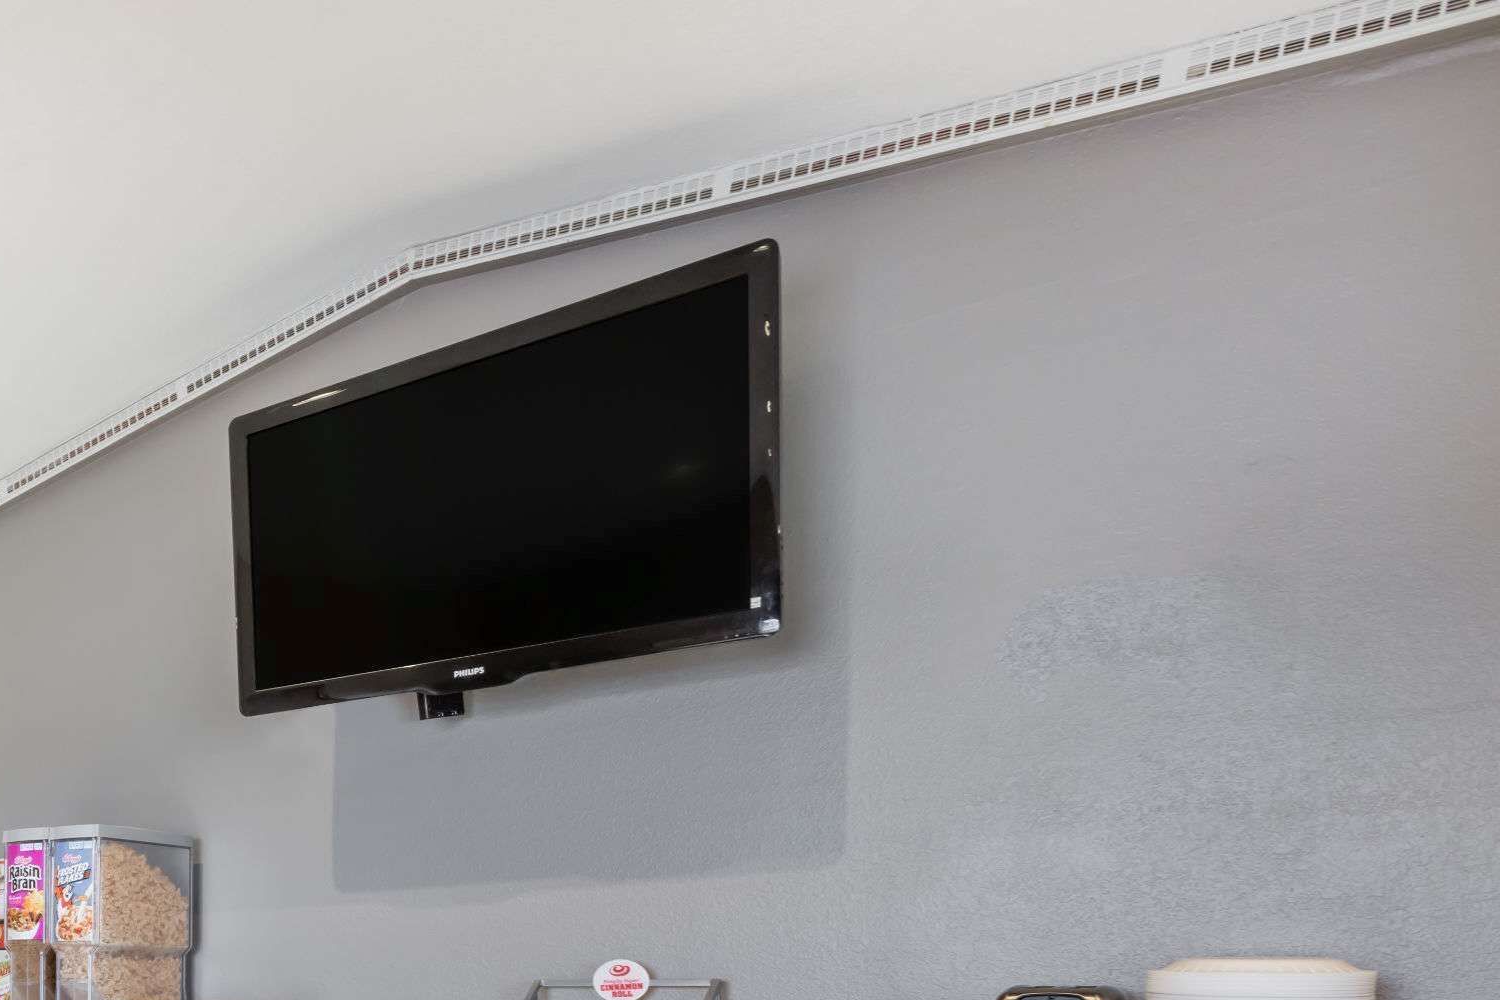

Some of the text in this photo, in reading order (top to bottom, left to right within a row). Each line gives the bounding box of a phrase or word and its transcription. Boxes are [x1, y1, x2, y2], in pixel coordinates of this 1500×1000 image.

[453, 666, 485, 678] PHILIPS
[9, 865, 41, 879] Raisin
[11, 878, 36, 891] Bran
[600, 982, 644, 991] CINNAMON
